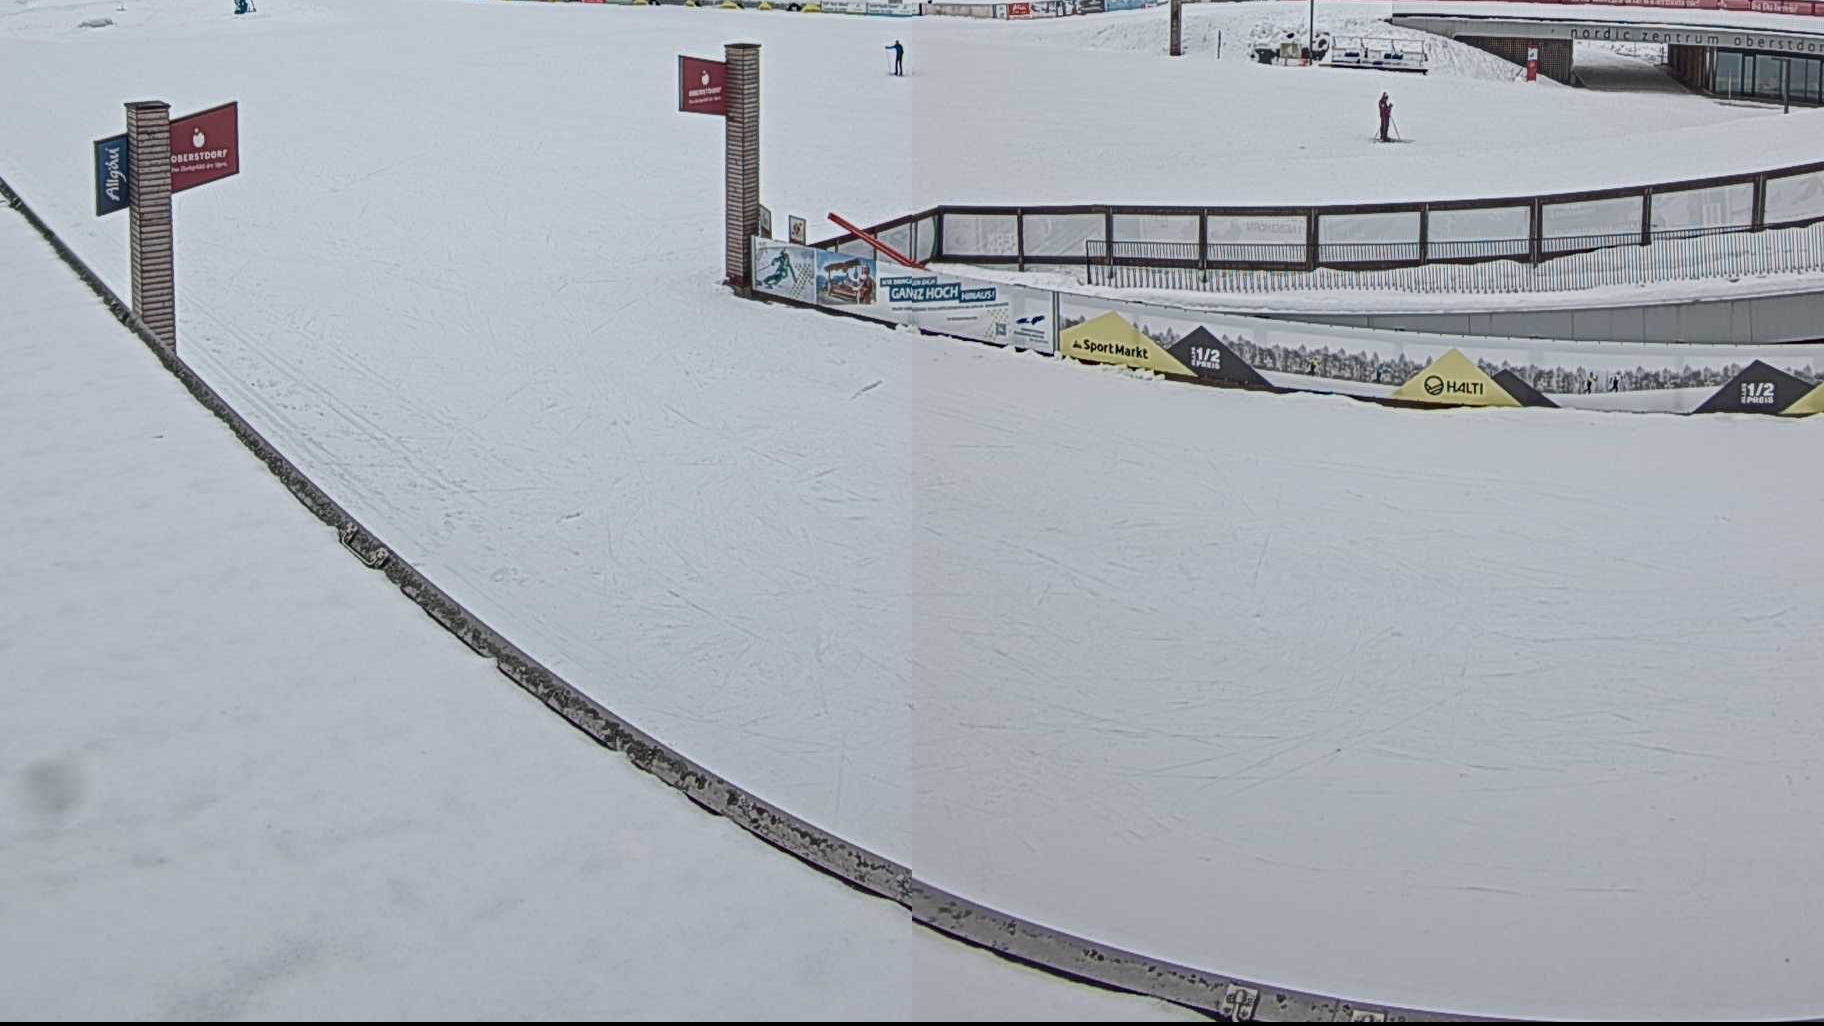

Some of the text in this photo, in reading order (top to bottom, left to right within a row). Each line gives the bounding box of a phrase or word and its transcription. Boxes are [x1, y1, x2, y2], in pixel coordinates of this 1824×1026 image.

[1571, 26, 1630, 40] nordic
[1641, 31, 1720, 45] zentrum
[171, 149, 228, 163] OBERSTDORF
[104, 147, 127, 202] Allgäu
[926, 285, 959, 300] HOCH
[1446, 380, 1484, 396] HALTI
[1747, 382, 1775, 397] 1/2
